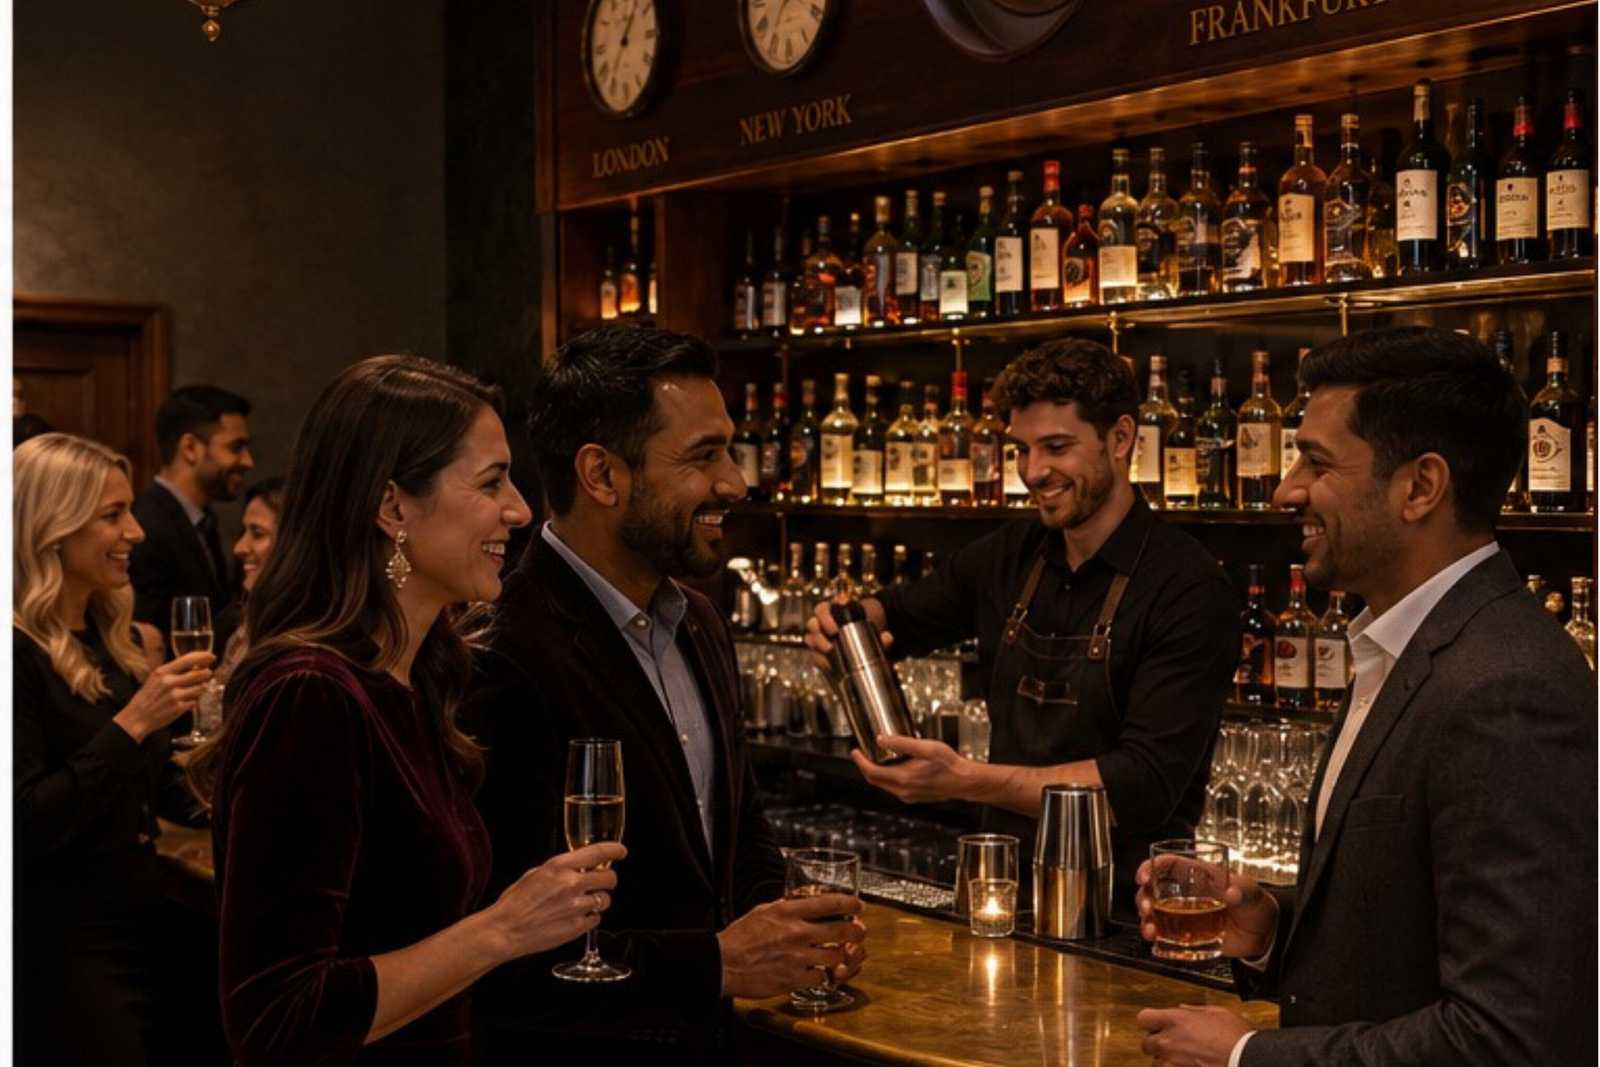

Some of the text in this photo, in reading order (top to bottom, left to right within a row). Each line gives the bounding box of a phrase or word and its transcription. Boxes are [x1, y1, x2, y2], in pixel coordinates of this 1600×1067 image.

[1189, 0, 1386, 45] FRANKF
[739, 95, 852, 145] NEW YORK
[592, 137, 669, 178] LONDON
